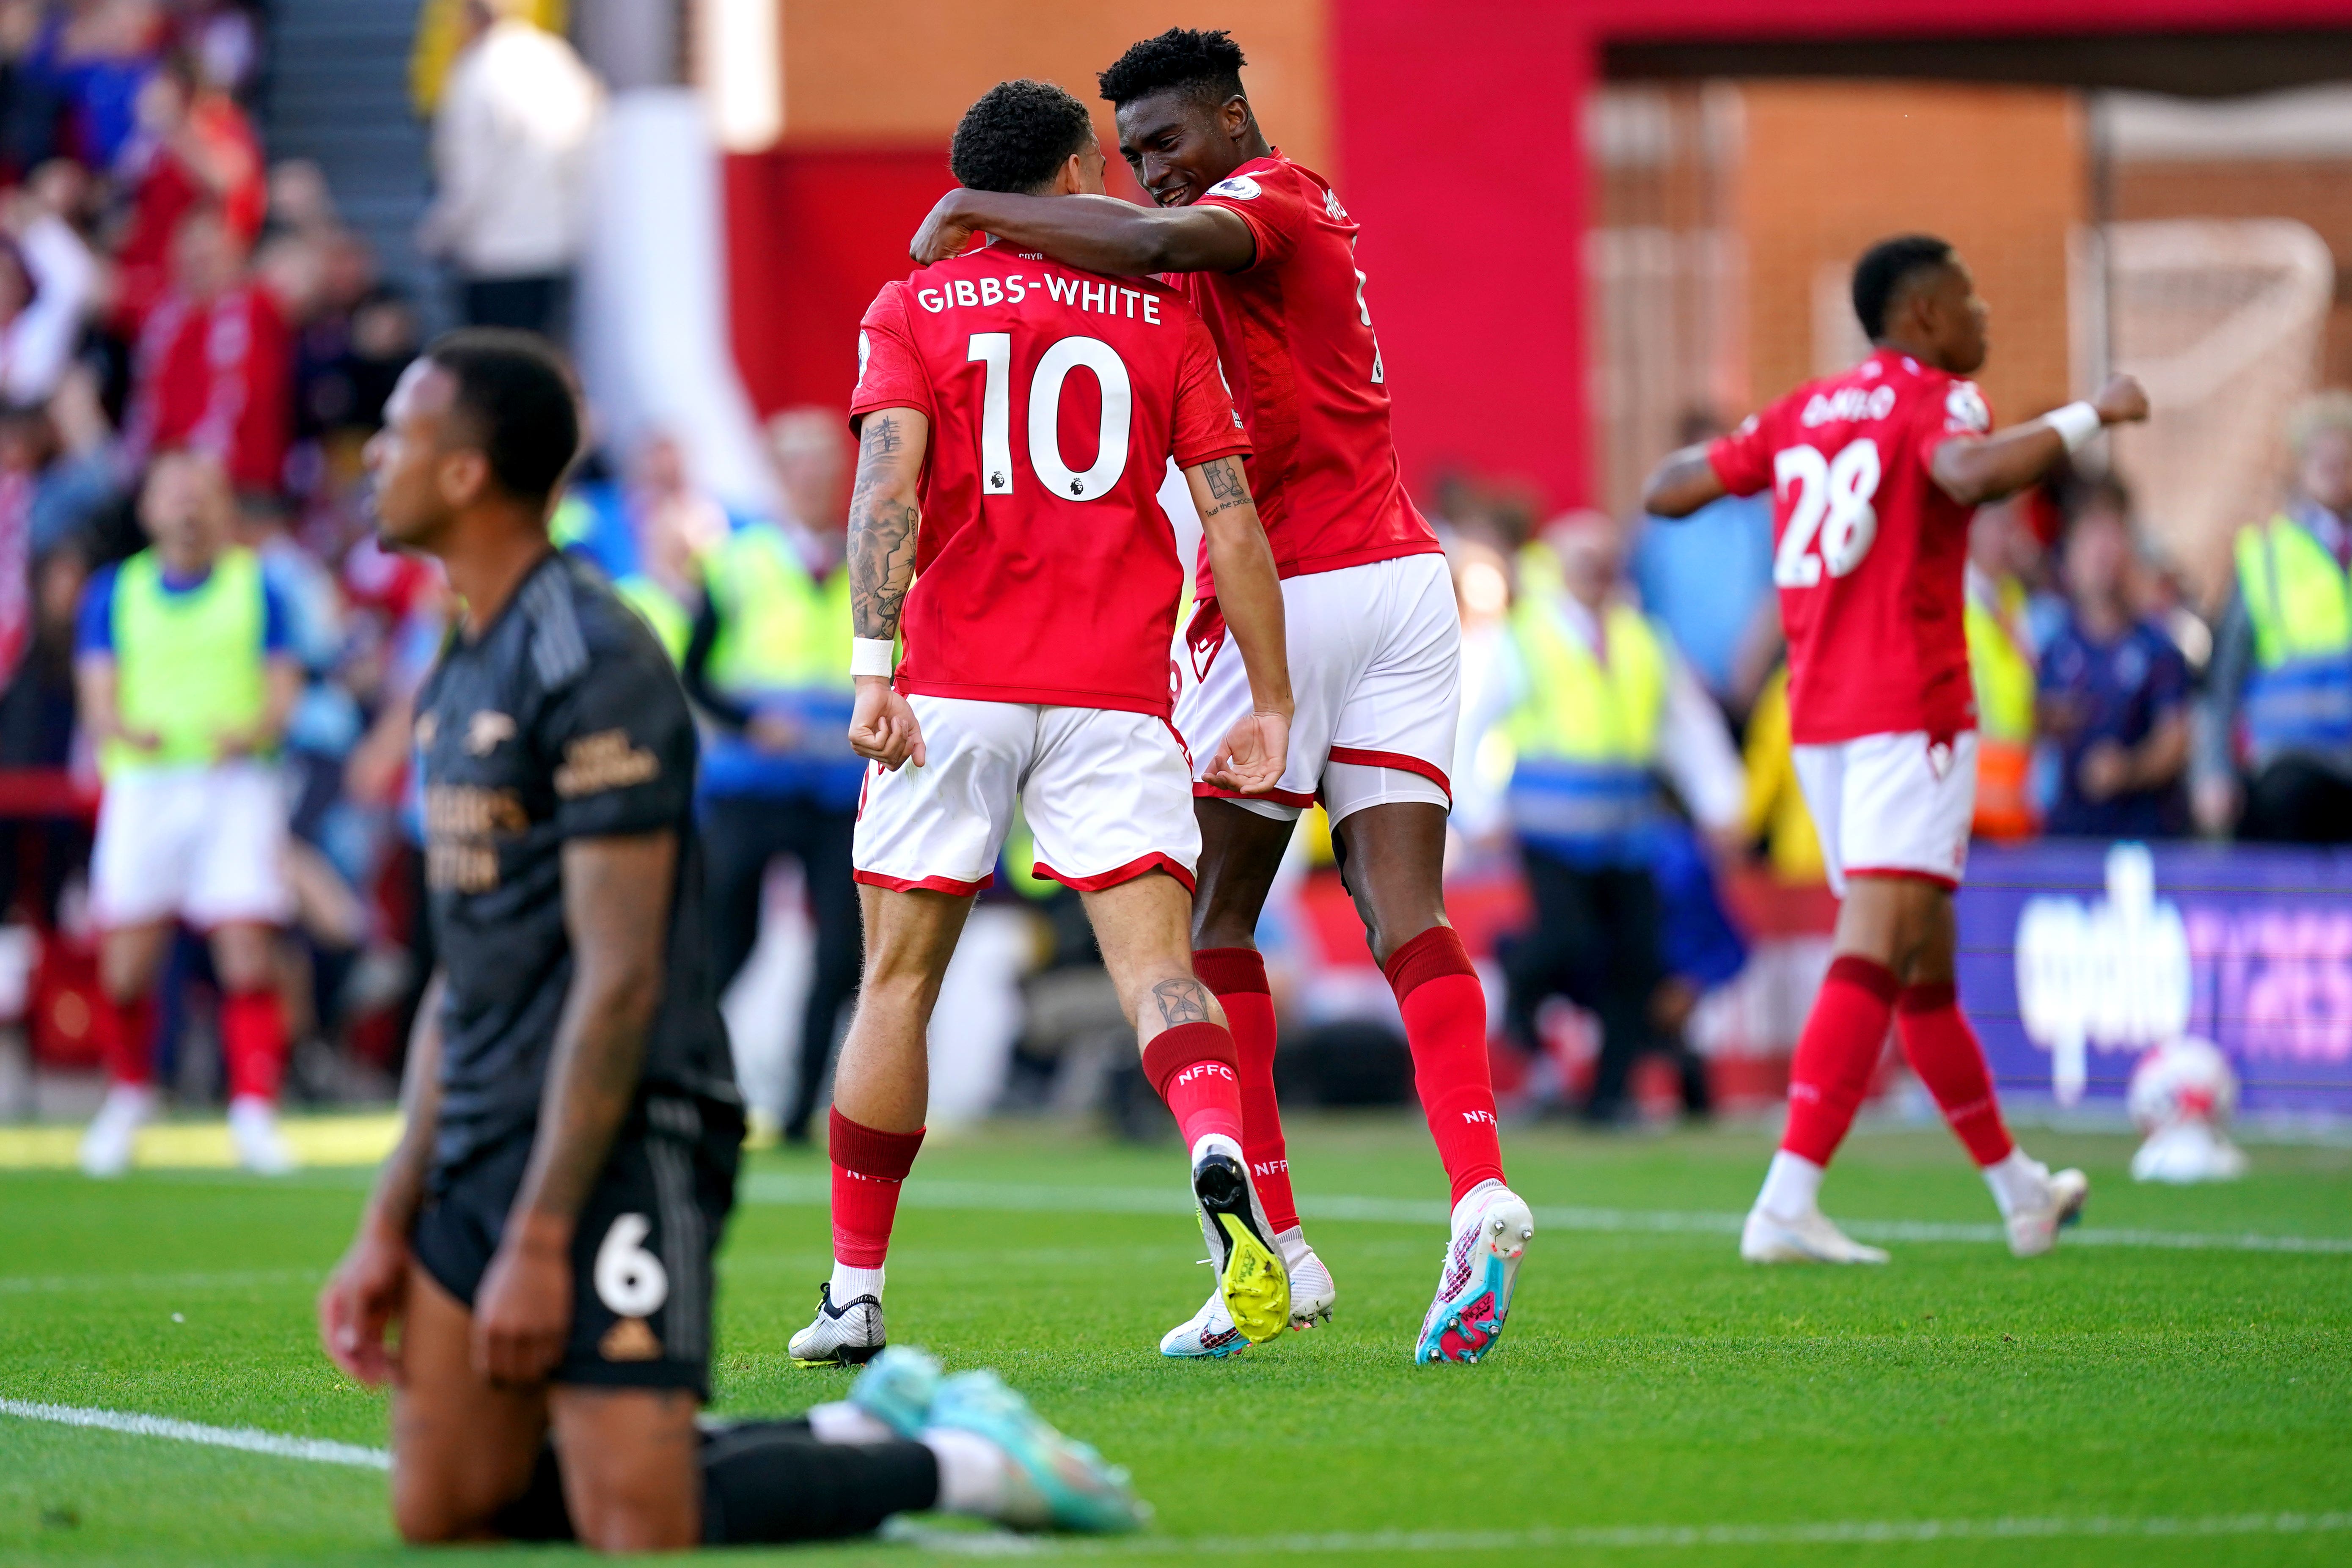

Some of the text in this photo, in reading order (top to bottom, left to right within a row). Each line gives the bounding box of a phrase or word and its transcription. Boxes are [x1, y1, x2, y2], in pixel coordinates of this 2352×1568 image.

[918, 273, 1161, 325] GIBBS-WHITE
[967, 332, 1132, 502] 10
[1205, 506, 1219, 517] Trust
[1220, 502, 1231, 510] the
[1773, 437, 1881, 589] 28
[1179, 1064, 1232, 1086] NFFC
[1462, 1110, 1498, 1135] NFF
[1254, 1160, 1289, 1177] NFF
[594, 1212, 668, 1318] 6
